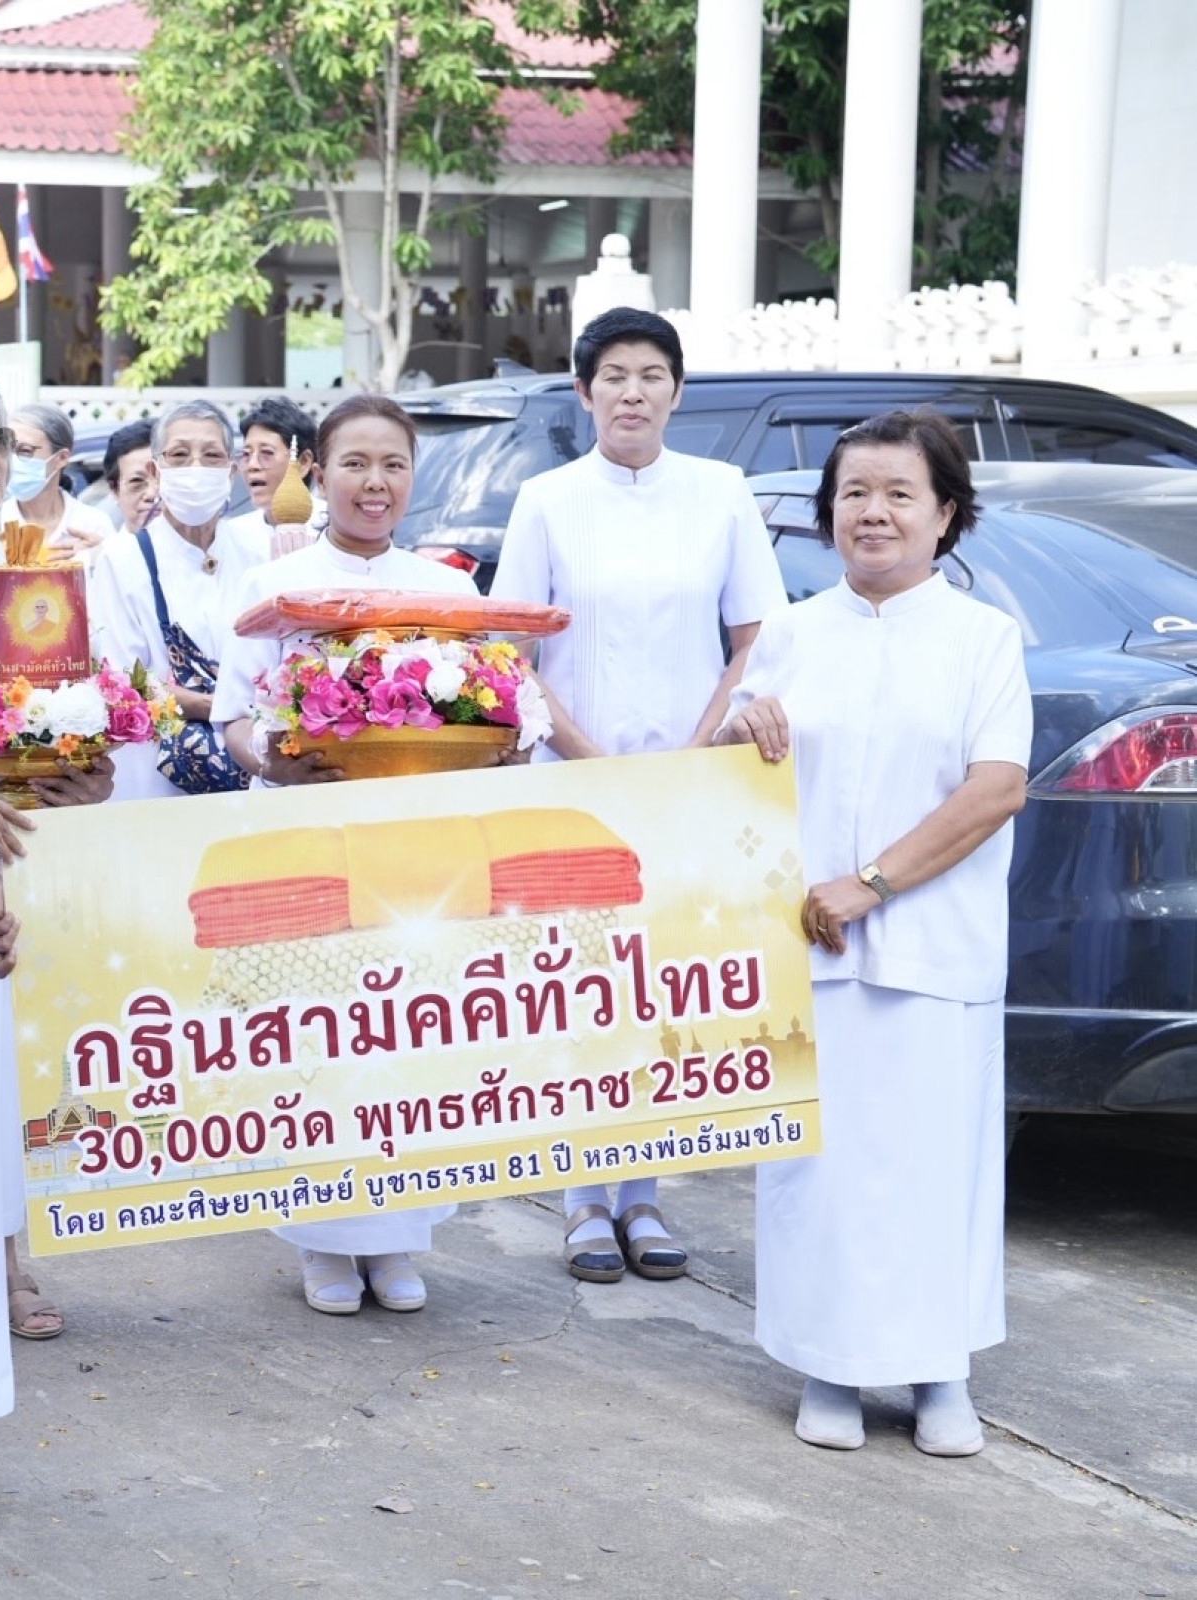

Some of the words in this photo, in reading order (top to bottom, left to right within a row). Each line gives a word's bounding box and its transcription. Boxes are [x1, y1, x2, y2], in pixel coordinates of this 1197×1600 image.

[73, 926, 762, 1109] กฐินสามัคคีทั่วไทย
[78, 1093, 334, 1175] 30,000วัด
[354, 1068, 630, 1158] พุทธศักราช
[651, 1049, 770, 1104] 2568
[49, 1206, 104, 1237] โดย
[119, 1169, 353, 1227] คณะศิษยานุศิษย์
[366, 1161, 495, 1207] บูชาธรรม
[508, 1153, 541, 1179] 81
[552, 1142, 572, 1172] ปี
[583, 1114, 801, 1168] หลวงพ่อธัมมชโย
